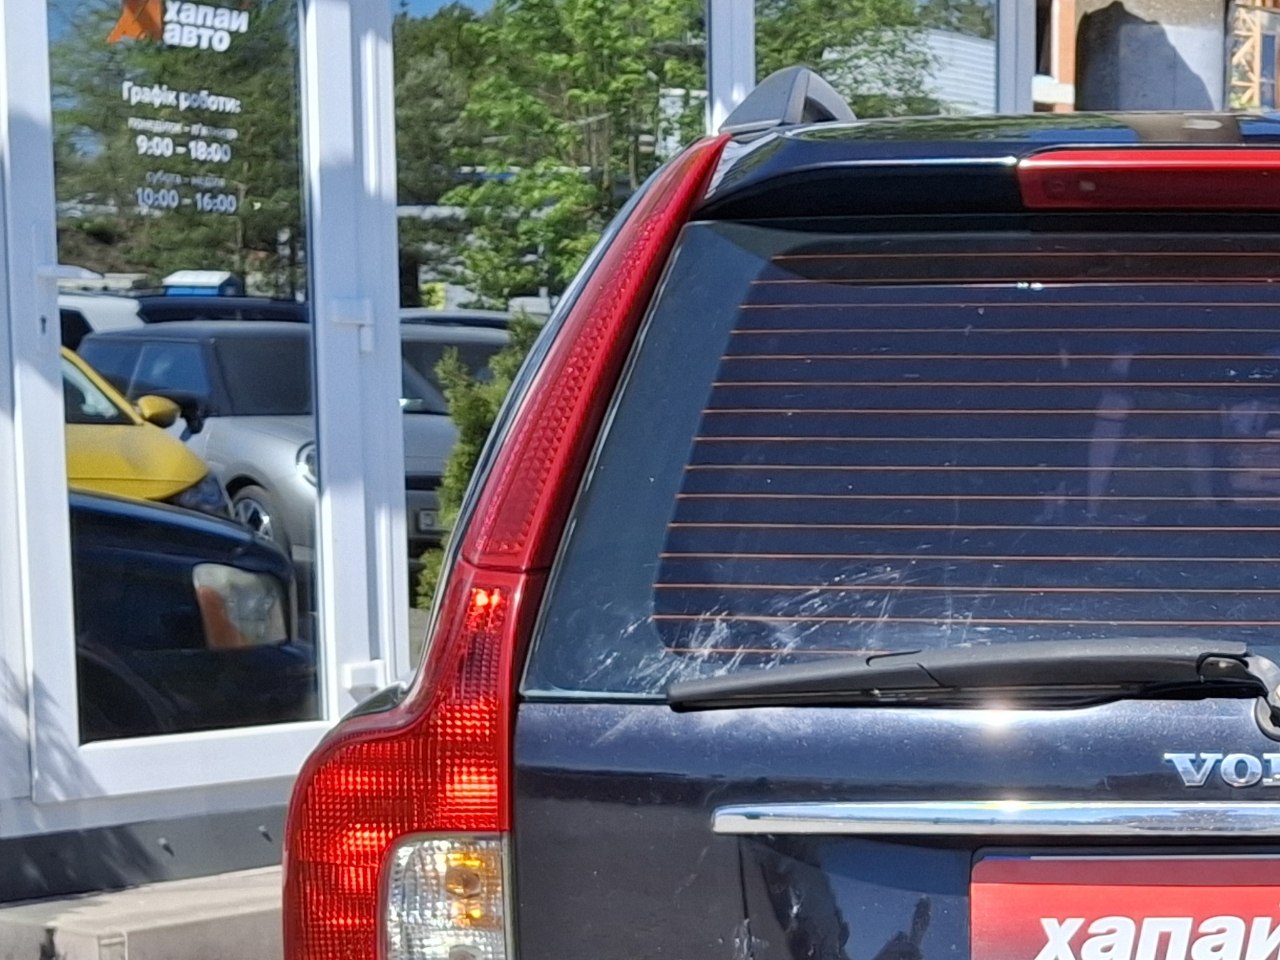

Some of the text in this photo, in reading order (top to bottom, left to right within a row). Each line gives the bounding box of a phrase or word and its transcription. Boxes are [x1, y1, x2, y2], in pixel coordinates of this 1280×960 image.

[163, 22, 231, 52] авто
[122, 81, 177, 108] Графік
[136, 134, 173, 157] 9:00
[189, 140, 231, 162] 18:00
[136, 187, 179, 208] 10:00
[196, 192, 236, 213] 16:00
